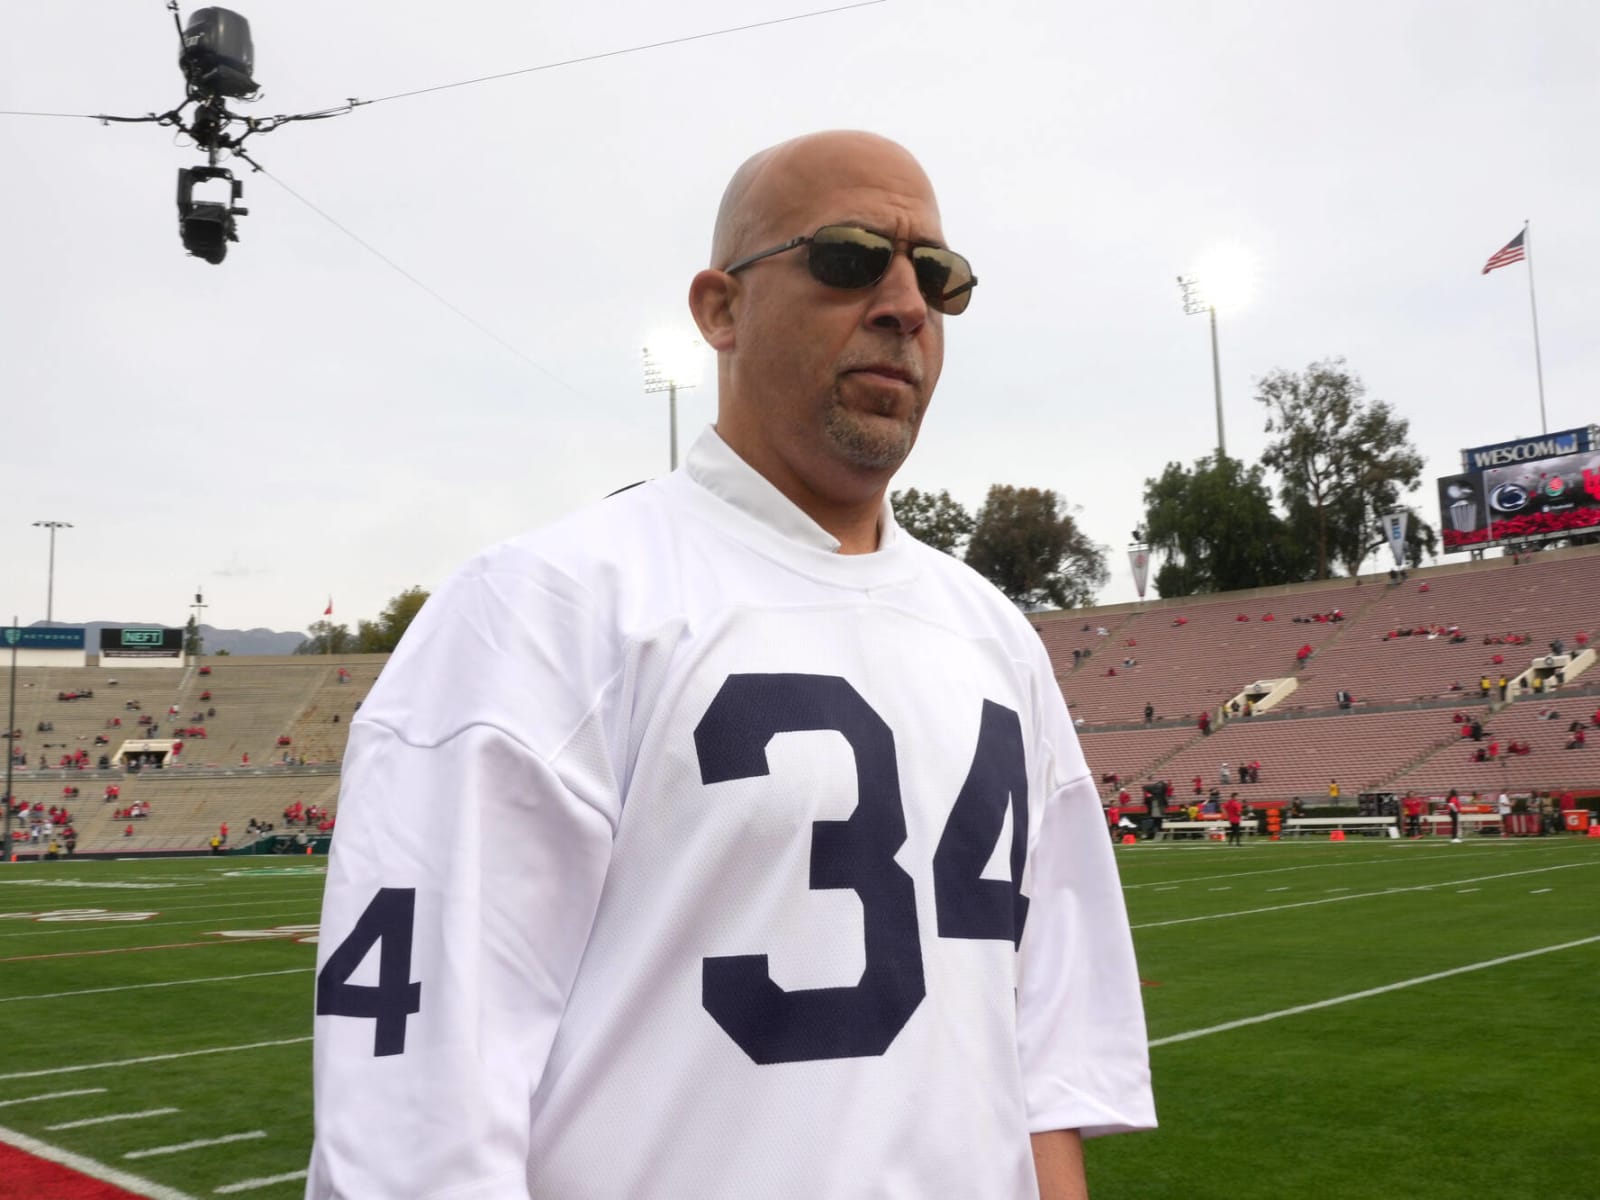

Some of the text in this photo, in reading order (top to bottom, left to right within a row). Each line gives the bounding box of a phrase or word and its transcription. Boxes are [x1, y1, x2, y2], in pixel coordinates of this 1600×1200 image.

[1474, 439, 1555, 468] WESCOM
[125, 632, 160, 642] NEFT
[693, 672, 1031, 1066] 34
[316, 887, 421, 1057] 4
